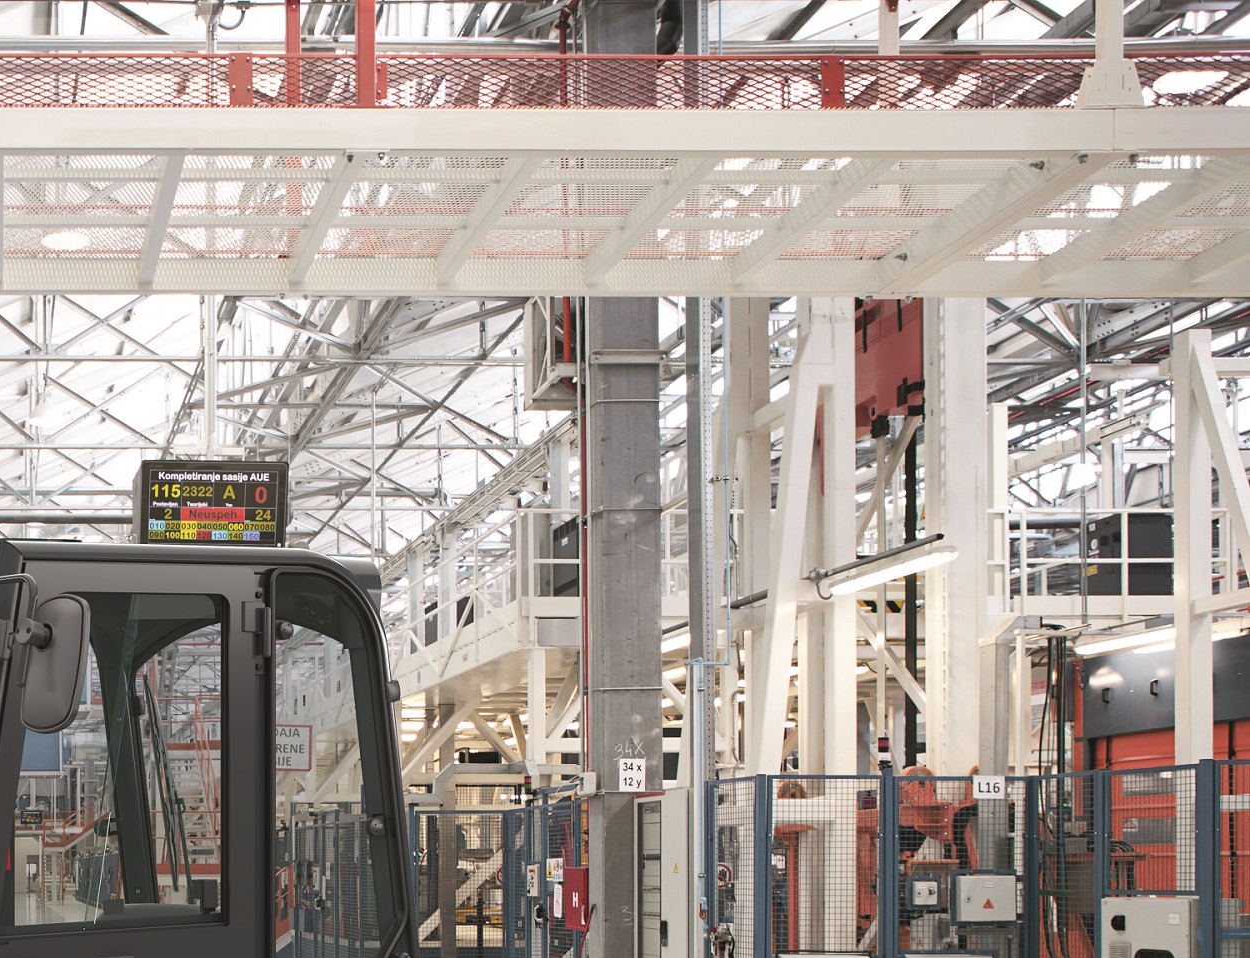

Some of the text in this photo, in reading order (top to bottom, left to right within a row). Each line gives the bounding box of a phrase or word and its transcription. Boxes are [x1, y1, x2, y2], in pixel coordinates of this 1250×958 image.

[158, 472, 270, 483] Kompletiranje sasije AUE
[151, 484, 268, 504] 115 2322 A 0
[164, 508, 271, 520] 2 Neuspeh 24
[228, 523, 244, 531] 060
[165, 531, 180, 539] 100
[213, 532, 228, 540] 130
[244, 532, 259, 540] 150
[622, 762, 642, 772] 34 x
[623, 777, 642, 789] 12 y
[978, 782, 1001, 793] L16
[572, 891, 579, 908] H
